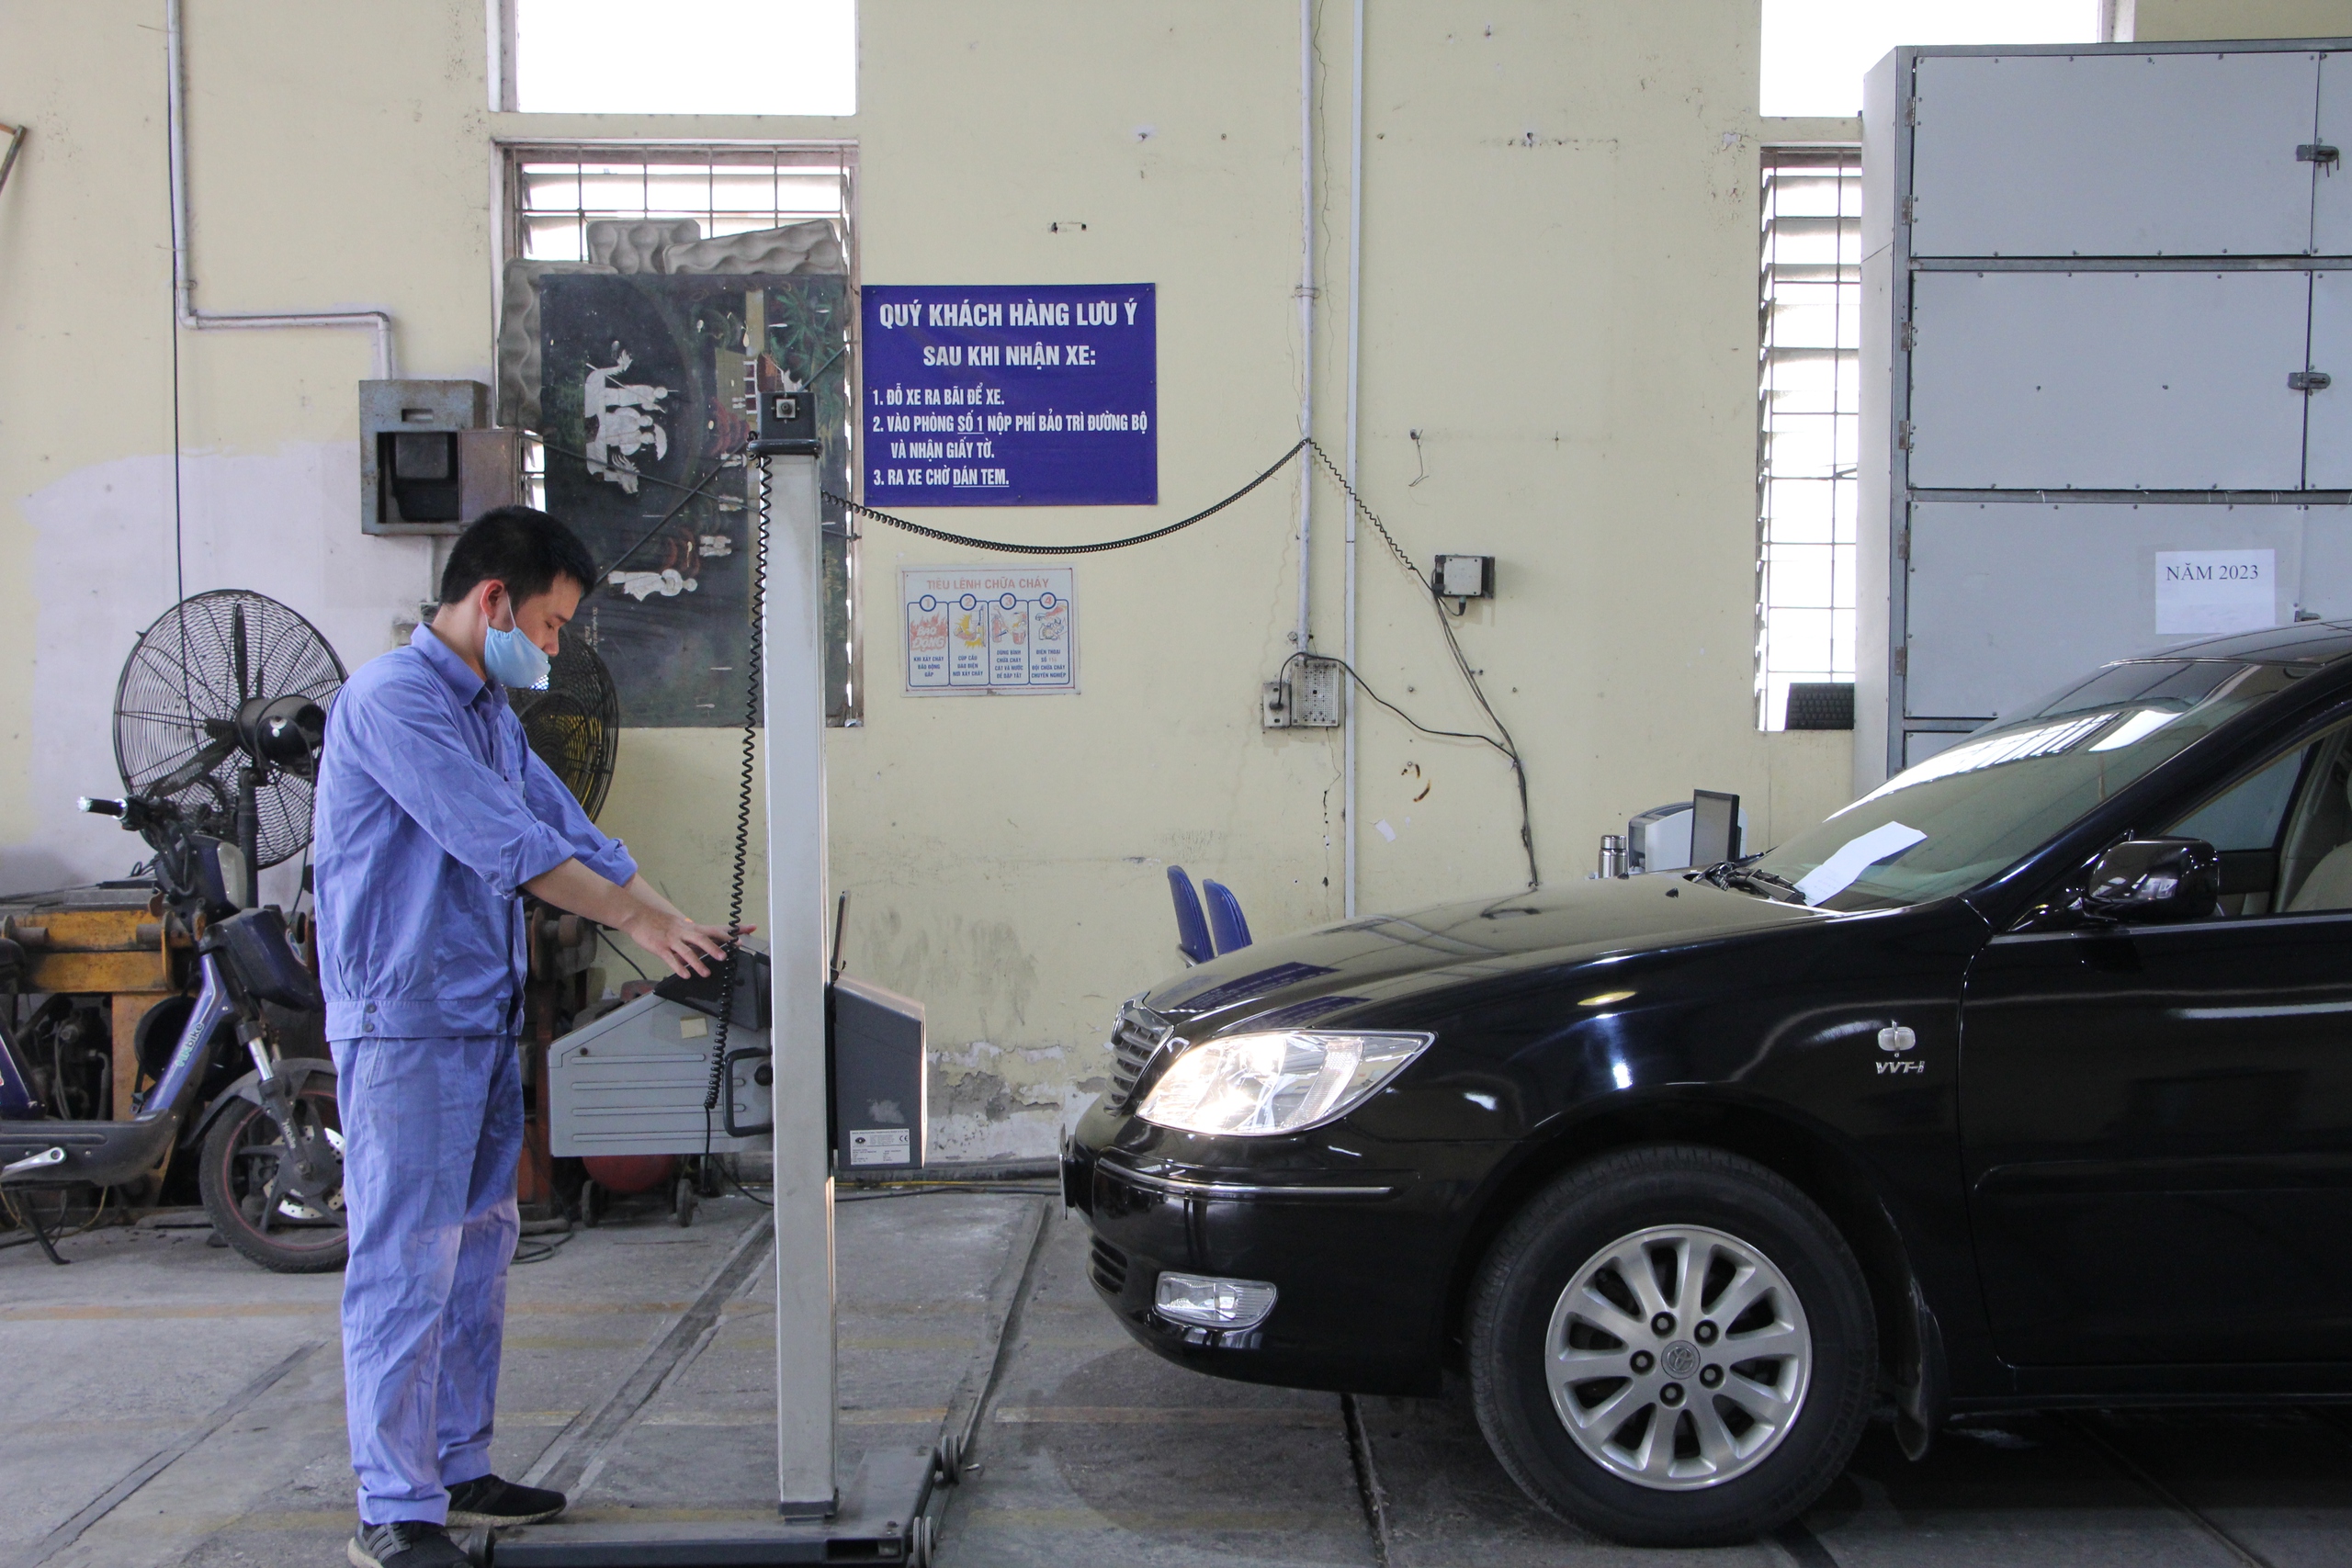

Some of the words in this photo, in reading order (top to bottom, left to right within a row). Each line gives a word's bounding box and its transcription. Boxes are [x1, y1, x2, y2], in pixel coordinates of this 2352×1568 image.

[880, 299, 922, 329] QUÝ
[930, 299, 1002, 327] KHÁCH
[1010, 299, 1069, 326] HÀNG
[1077, 301, 1117, 325] LƯU
[1125, 299, 1137, 325] Ý
[923, 345, 961, 366] SAU
[968, 345, 1000, 366] KHI
[1006, 342, 1059, 369] NHẬN
[1066, 345, 1095, 365] XE:
[873, 390, 883, 405] 1.
[887, 383, 901, 405] ĐỖ
[907, 389, 921, 405] XE
[925, 389, 941, 405] RA
[944, 387, 963, 405] BÃI
[967, 383, 982, 405] ĐỂ
[986, 389, 1004, 404] XE.
[873, 417, 884, 432] 2.
[888, 412, 910, 432] VÀO
[914, 412, 954, 432] PHÒNG
[957, 410, 974, 432] SỐ
[978, 416, 983, 431] 1
[988, 412, 1012, 435] NỘP
[1015, 412, 1035, 431] PHÍ
[1039, 409, 1062, 431] BẢO
[1067, 411, 1084, 431] TRÌ
[1088, 411, 1127, 431] ĐƯỜNG
[1132, 411, 1147, 435] BỘ
[891, 438, 906, 458] VÀ
[910, 438, 943, 462] NHẬN
[946, 436, 973, 458] GIẤY
[977, 441, 994, 457] TỜ.
[874, 470, 884, 485] 3.
[888, 470, 904, 485] RA
[908, 470, 922, 485] XE
[926, 465, 950, 485] CHỜ
[954, 467, 978, 485] DÁN
[981, 469, 1009, 485] TEM.
[2166, 563, 2212, 581] NĂM
[2219, 565, 2258, 580] 2023
[927, 578, 950, 590] TIÊU
[954, 578, 981, 592] LỆNH
[985, 577, 1015, 589] CHỮA
[1019, 576, 1049, 589] CHÁY
[925, 598, 930, 607] 1
[965, 597, 971, 606] 2
[1005, 596, 1012, 606] 3
[1045, 596, 1051, 604] 4
[175, 1021, 205, 1067] HKbike
